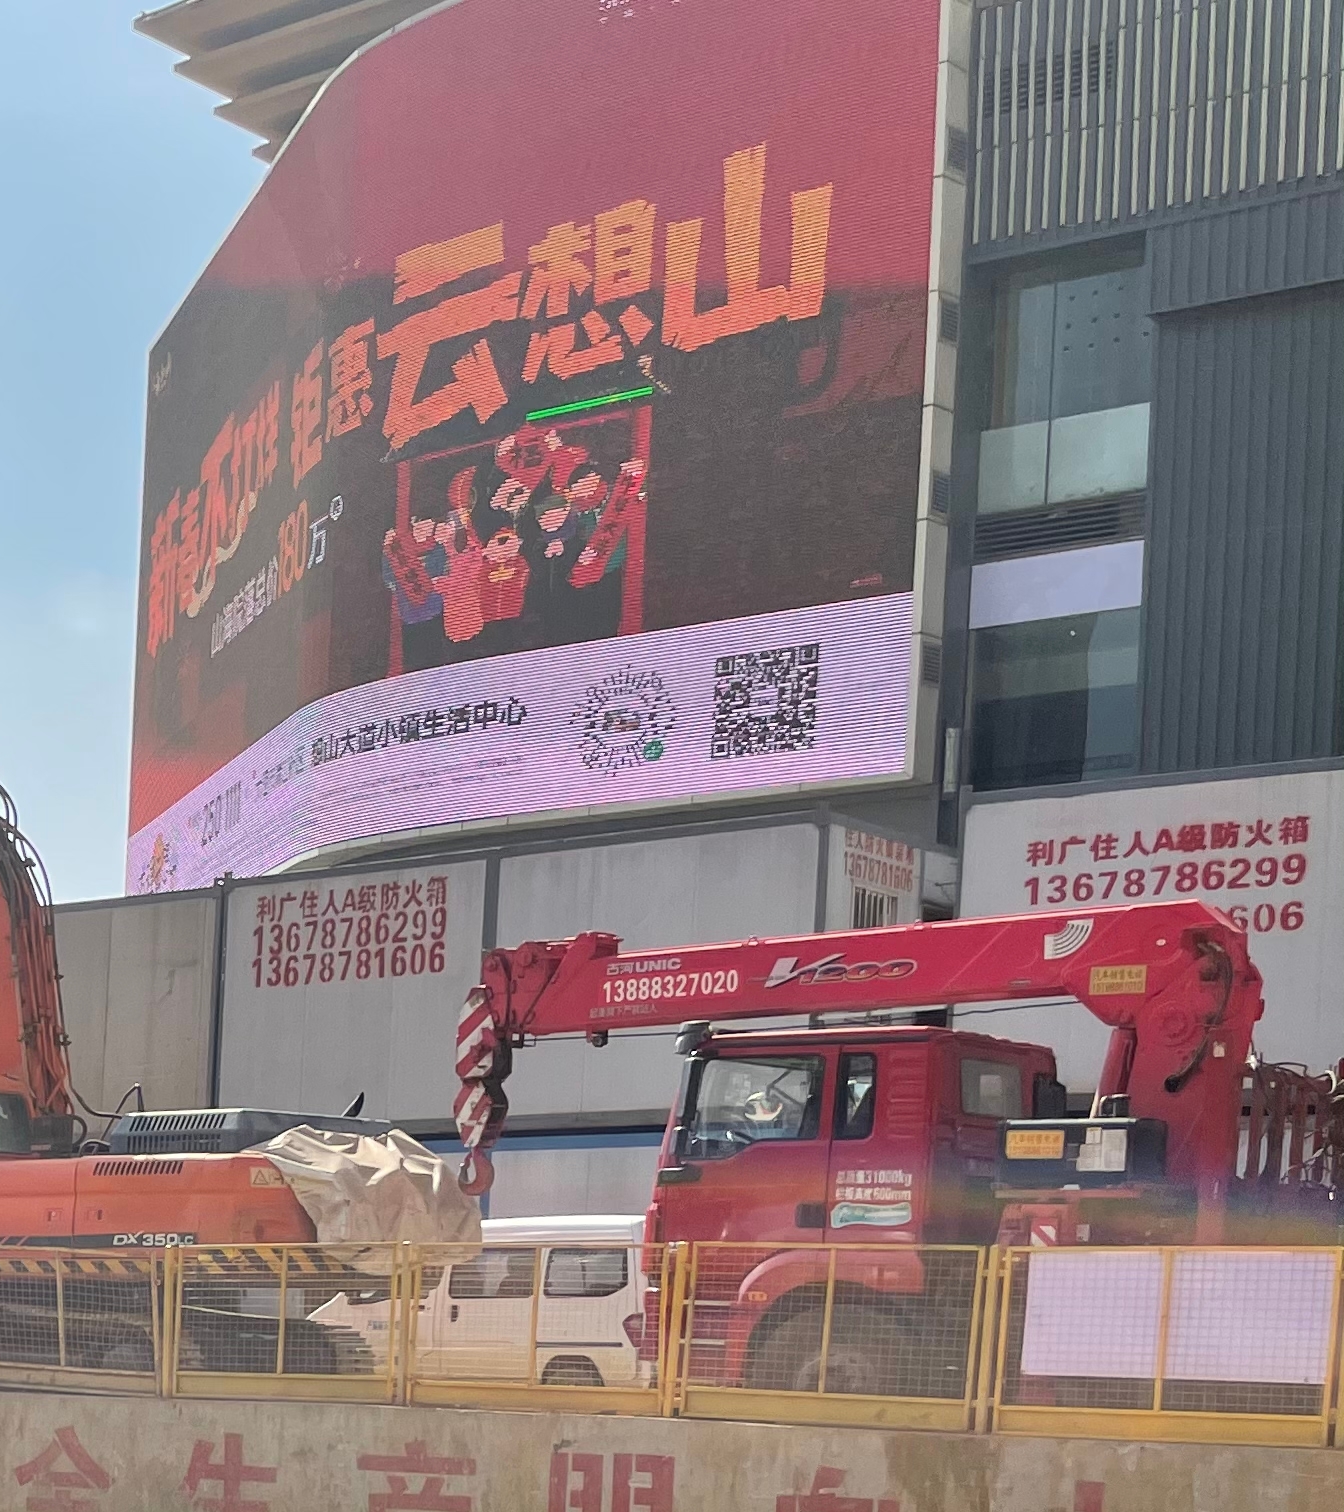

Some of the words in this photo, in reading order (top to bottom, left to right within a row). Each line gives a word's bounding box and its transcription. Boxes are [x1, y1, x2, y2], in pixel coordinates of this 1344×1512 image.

[376, 140, 833, 450] 云想山
[1026, 815, 1310, 867] 利广住人A级防火箱
[844, 851, 914, 892] 13678781606
[1024, 853, 1307, 905] 13678786299
[256, 876, 449, 923] 利广住人A级防火箱
[252, 906, 447, 956] 13678786299
[251, 941, 445, 988] 13678781606
[602, 969, 739, 1003] 13888327020
